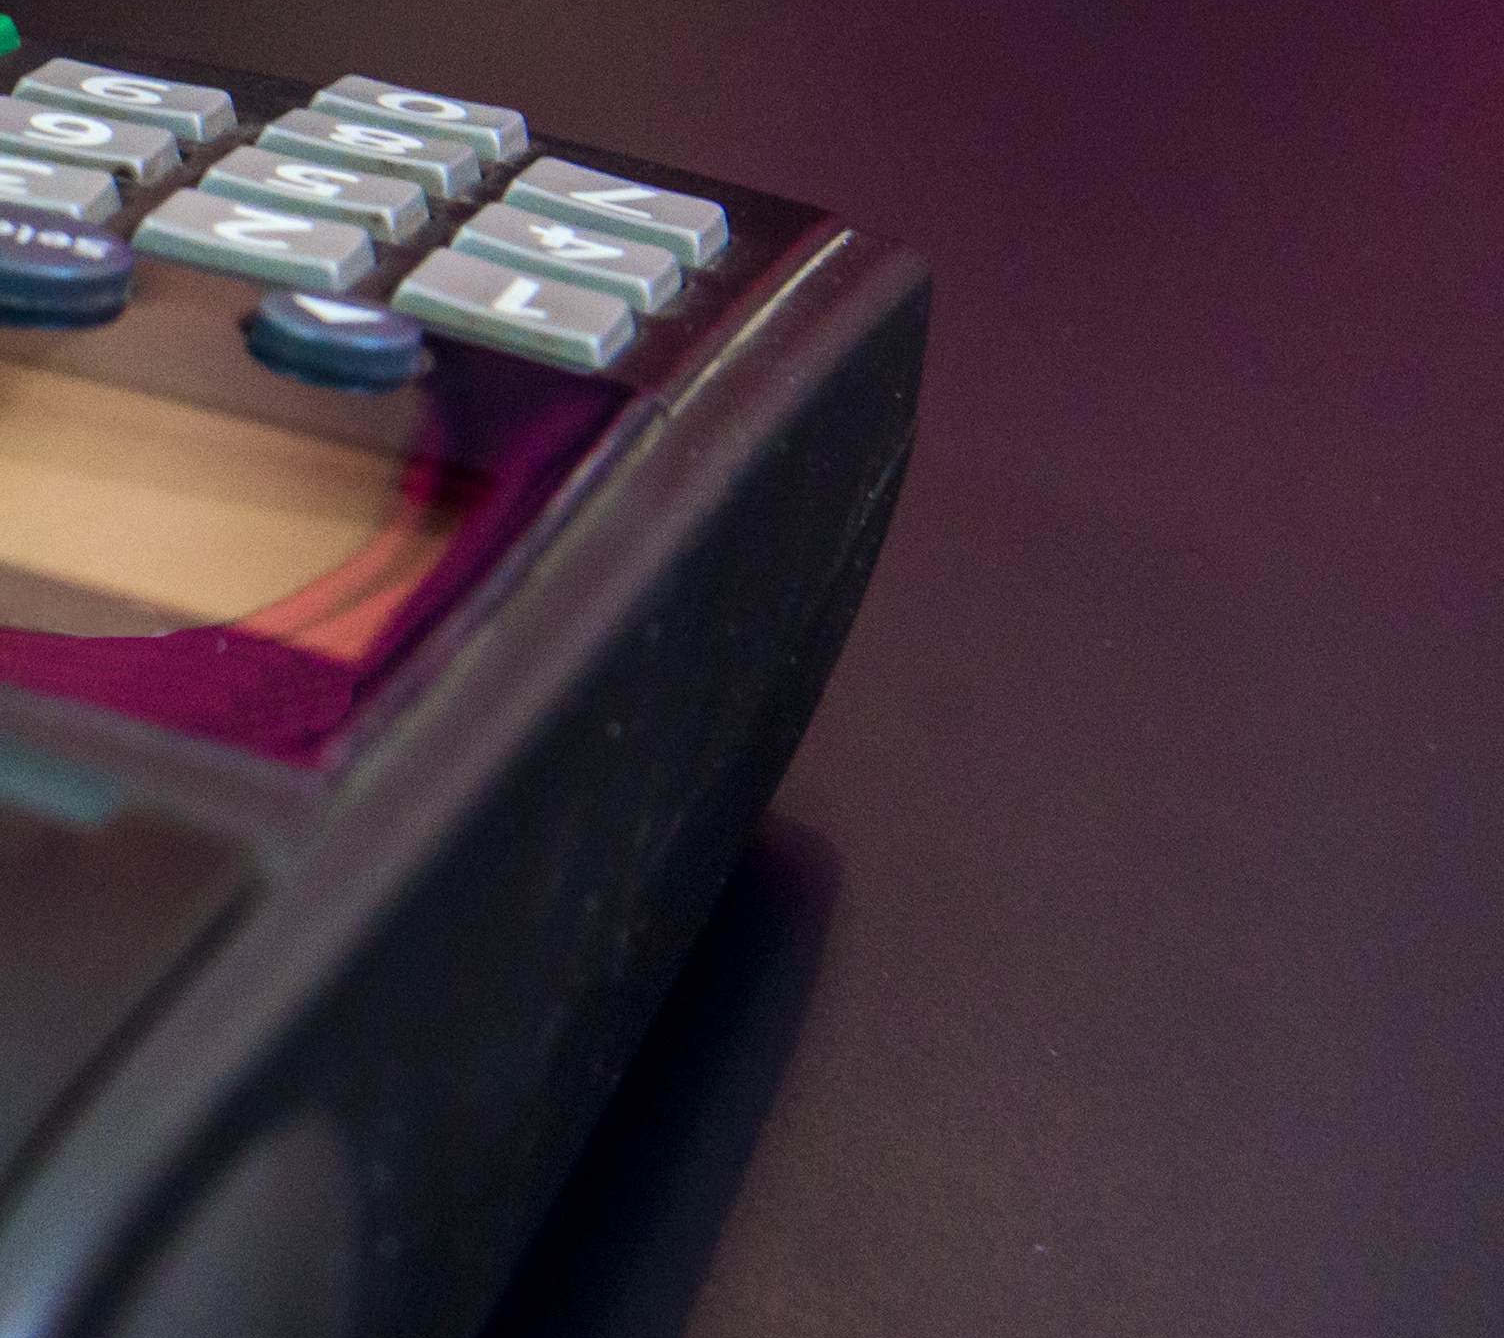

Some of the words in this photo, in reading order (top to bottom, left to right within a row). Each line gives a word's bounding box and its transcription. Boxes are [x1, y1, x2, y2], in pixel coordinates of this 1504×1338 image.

[81, 75, 172, 107] 9
[23, 111, 114, 147] 6
[329, 123, 425, 156] 8
[264, 163, 362, 199] 5
[570, 186, 660, 220] 7
[213, 203, 315, 250] 2
[528, 222, 626, 261] 4
[493, 276, 548, 320] 1
